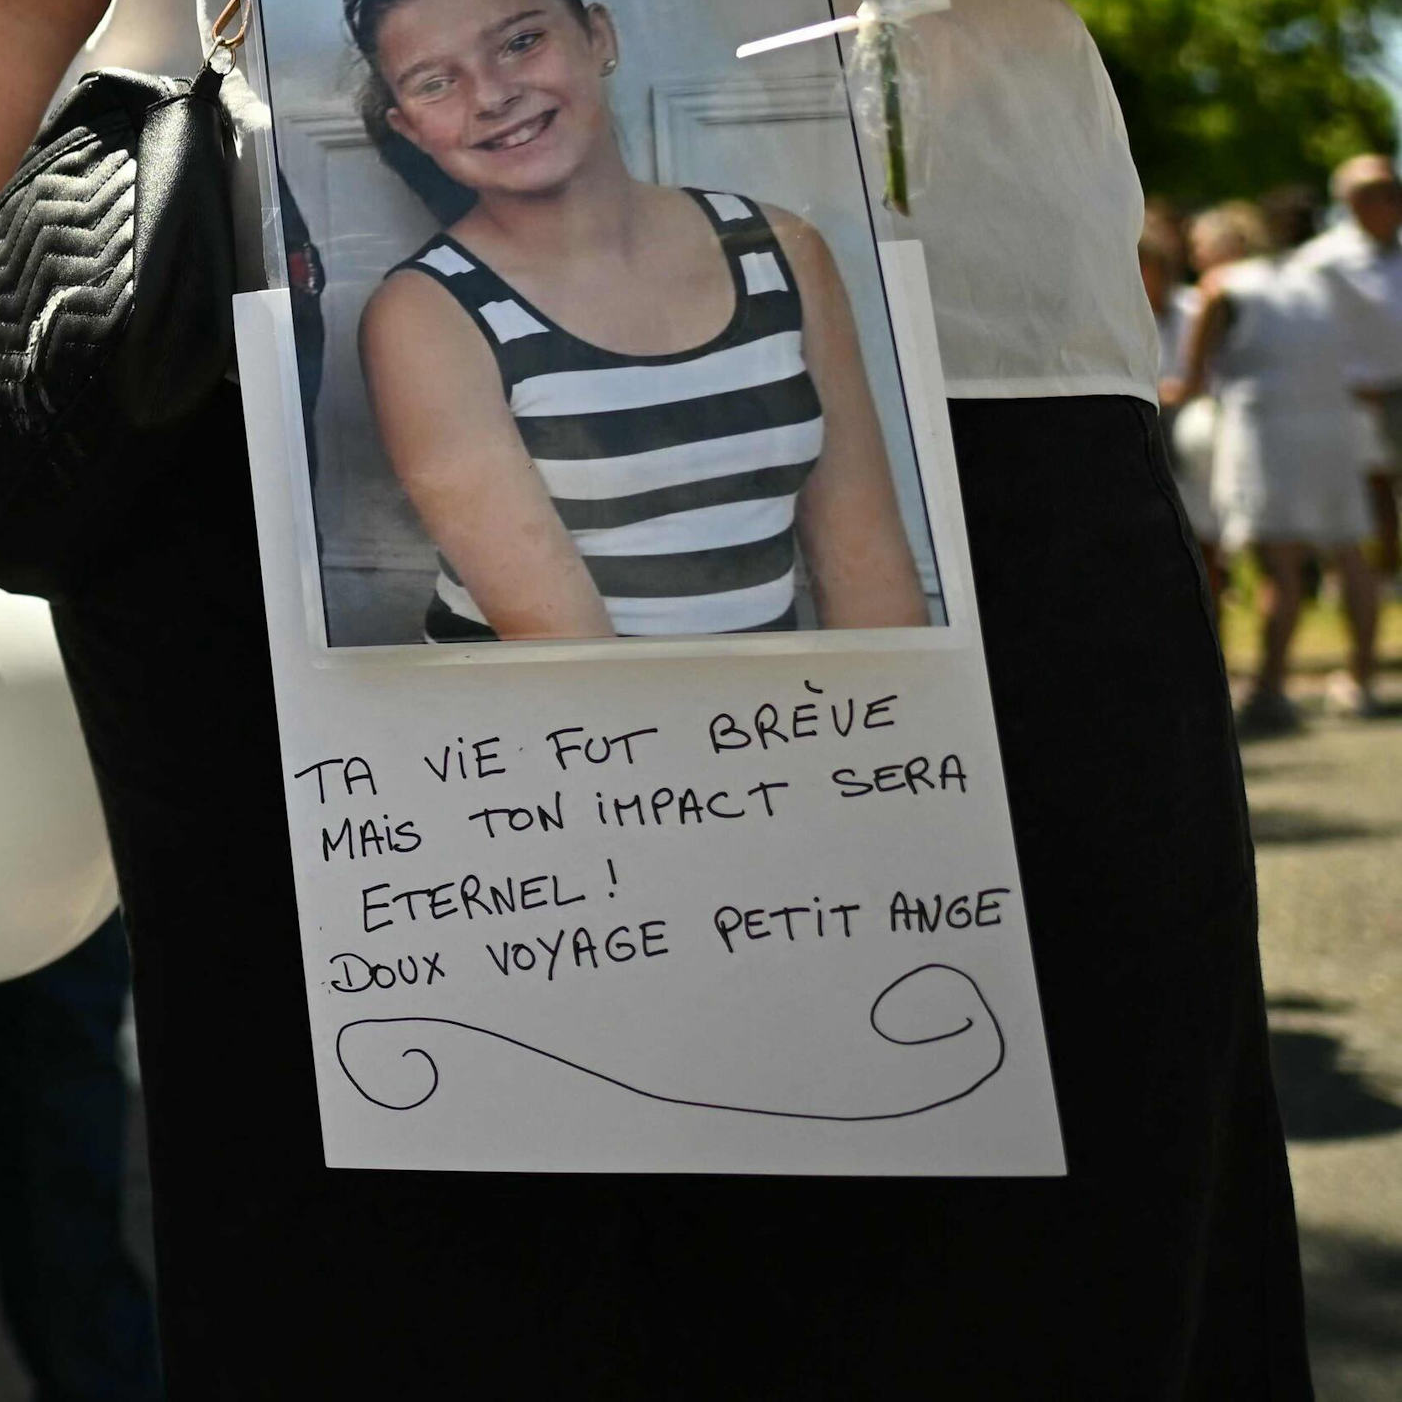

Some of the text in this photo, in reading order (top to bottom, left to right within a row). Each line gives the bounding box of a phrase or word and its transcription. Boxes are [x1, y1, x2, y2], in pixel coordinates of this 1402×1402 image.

[294, 756, 378, 804] TA
[545, 727, 658, 771] FUT
[709, 680, 898, 754] BRÈVE
[468, 790, 564, 838] TON
[831, 754, 967, 798] SERA
[330, 952, 445, 992] DOUX
[486, 920, 669, 981] VOYAGE
[890, 887, 1011, 934] ANGE
[362, 874, 586, 933] ETERNEL
